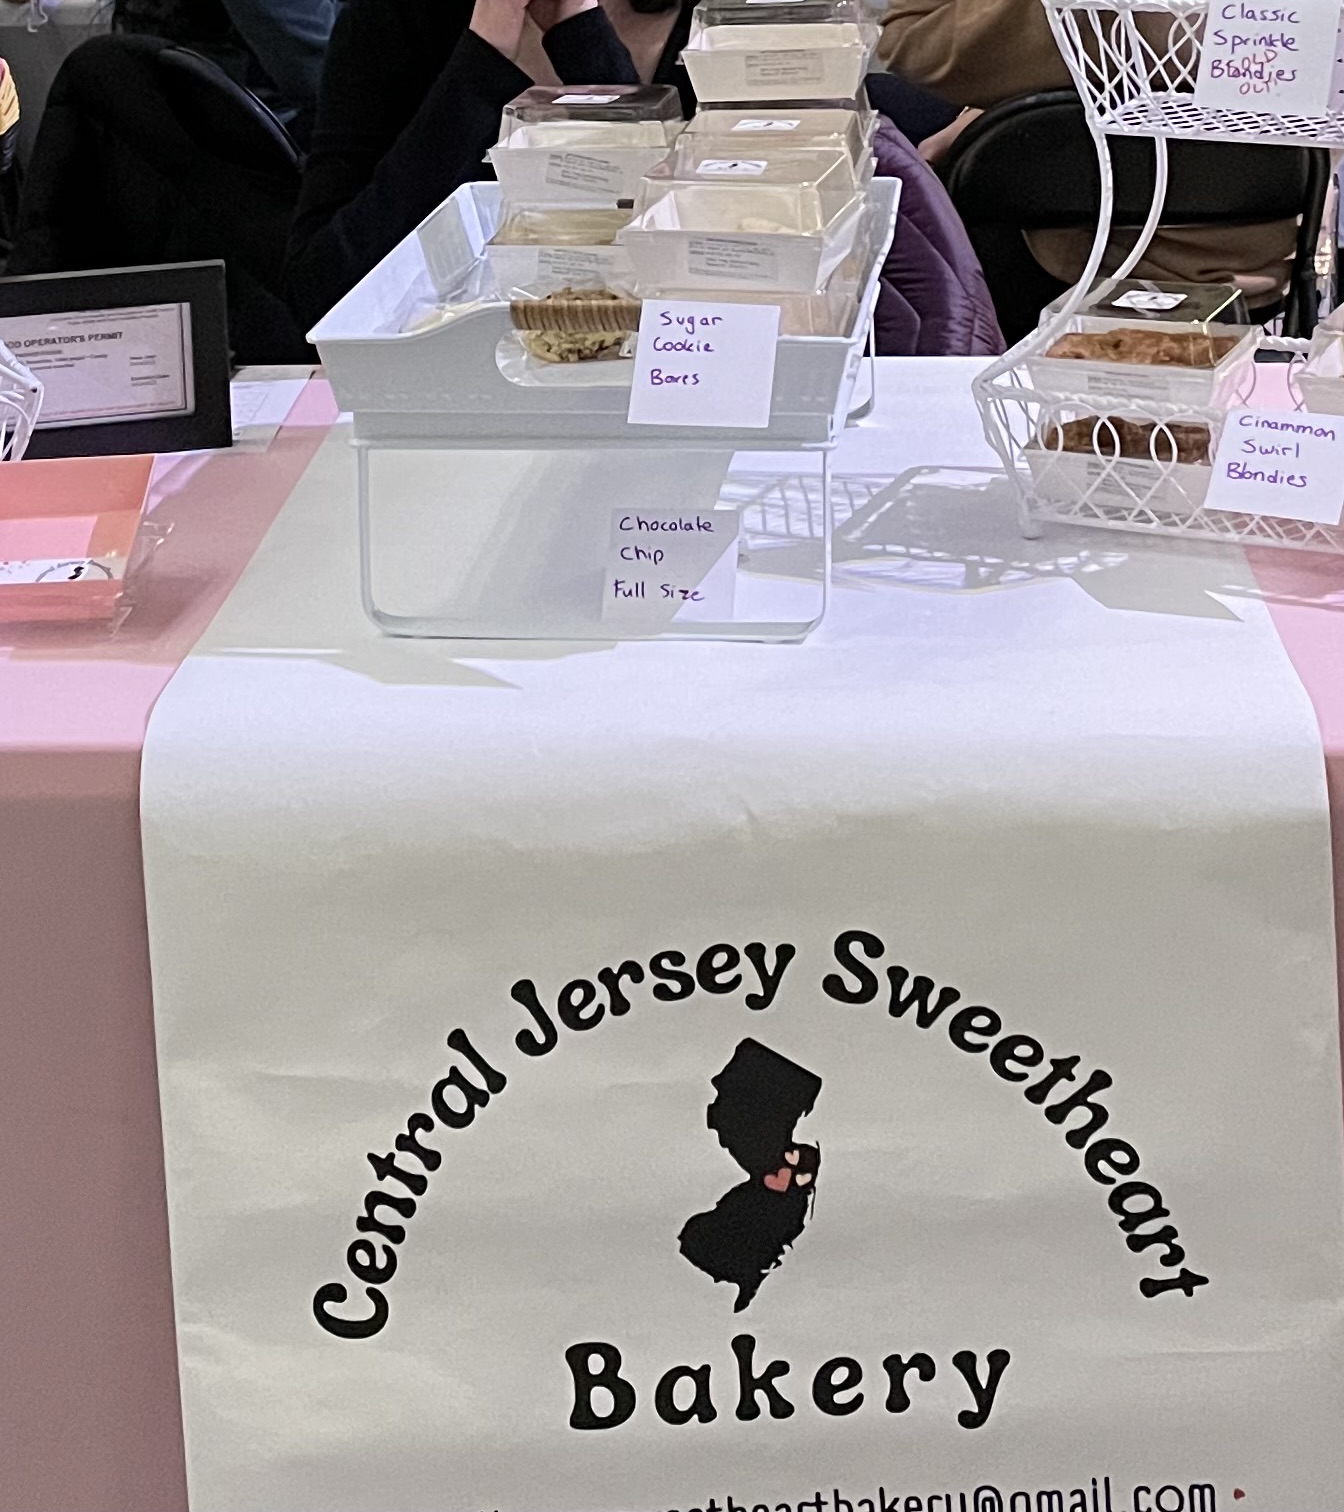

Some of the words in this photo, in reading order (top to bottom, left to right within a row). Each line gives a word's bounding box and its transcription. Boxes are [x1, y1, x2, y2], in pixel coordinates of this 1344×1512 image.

[1222, 2, 1300, 24] Classic
[1213, 29, 1299, 55] Sprinkle
[659, 310, 724, 336] Sugar
[23, 335, 86, 348] OPERATOR'S
[87, 331, 124, 343] PERMIT
[653, 336, 715, 353] Cookie
[1239, 415, 1336, 442] Cinammon
[1240, 438, 1300, 458] Swirl
[1226, 461, 1308, 488] Blondies
[619, 515, 715, 533] Chocolate
[620, 545, 665, 566] Chip
[613, 579, 646, 599] Full
[659, 583, 705, 602] Size
[312, 1027, 508, 1340] Central
[509, 940, 797, 1057] Jersey
[821, 929, 1210, 1300] Sweetheart
[564, 1333, 1012, 1431] Bakery
